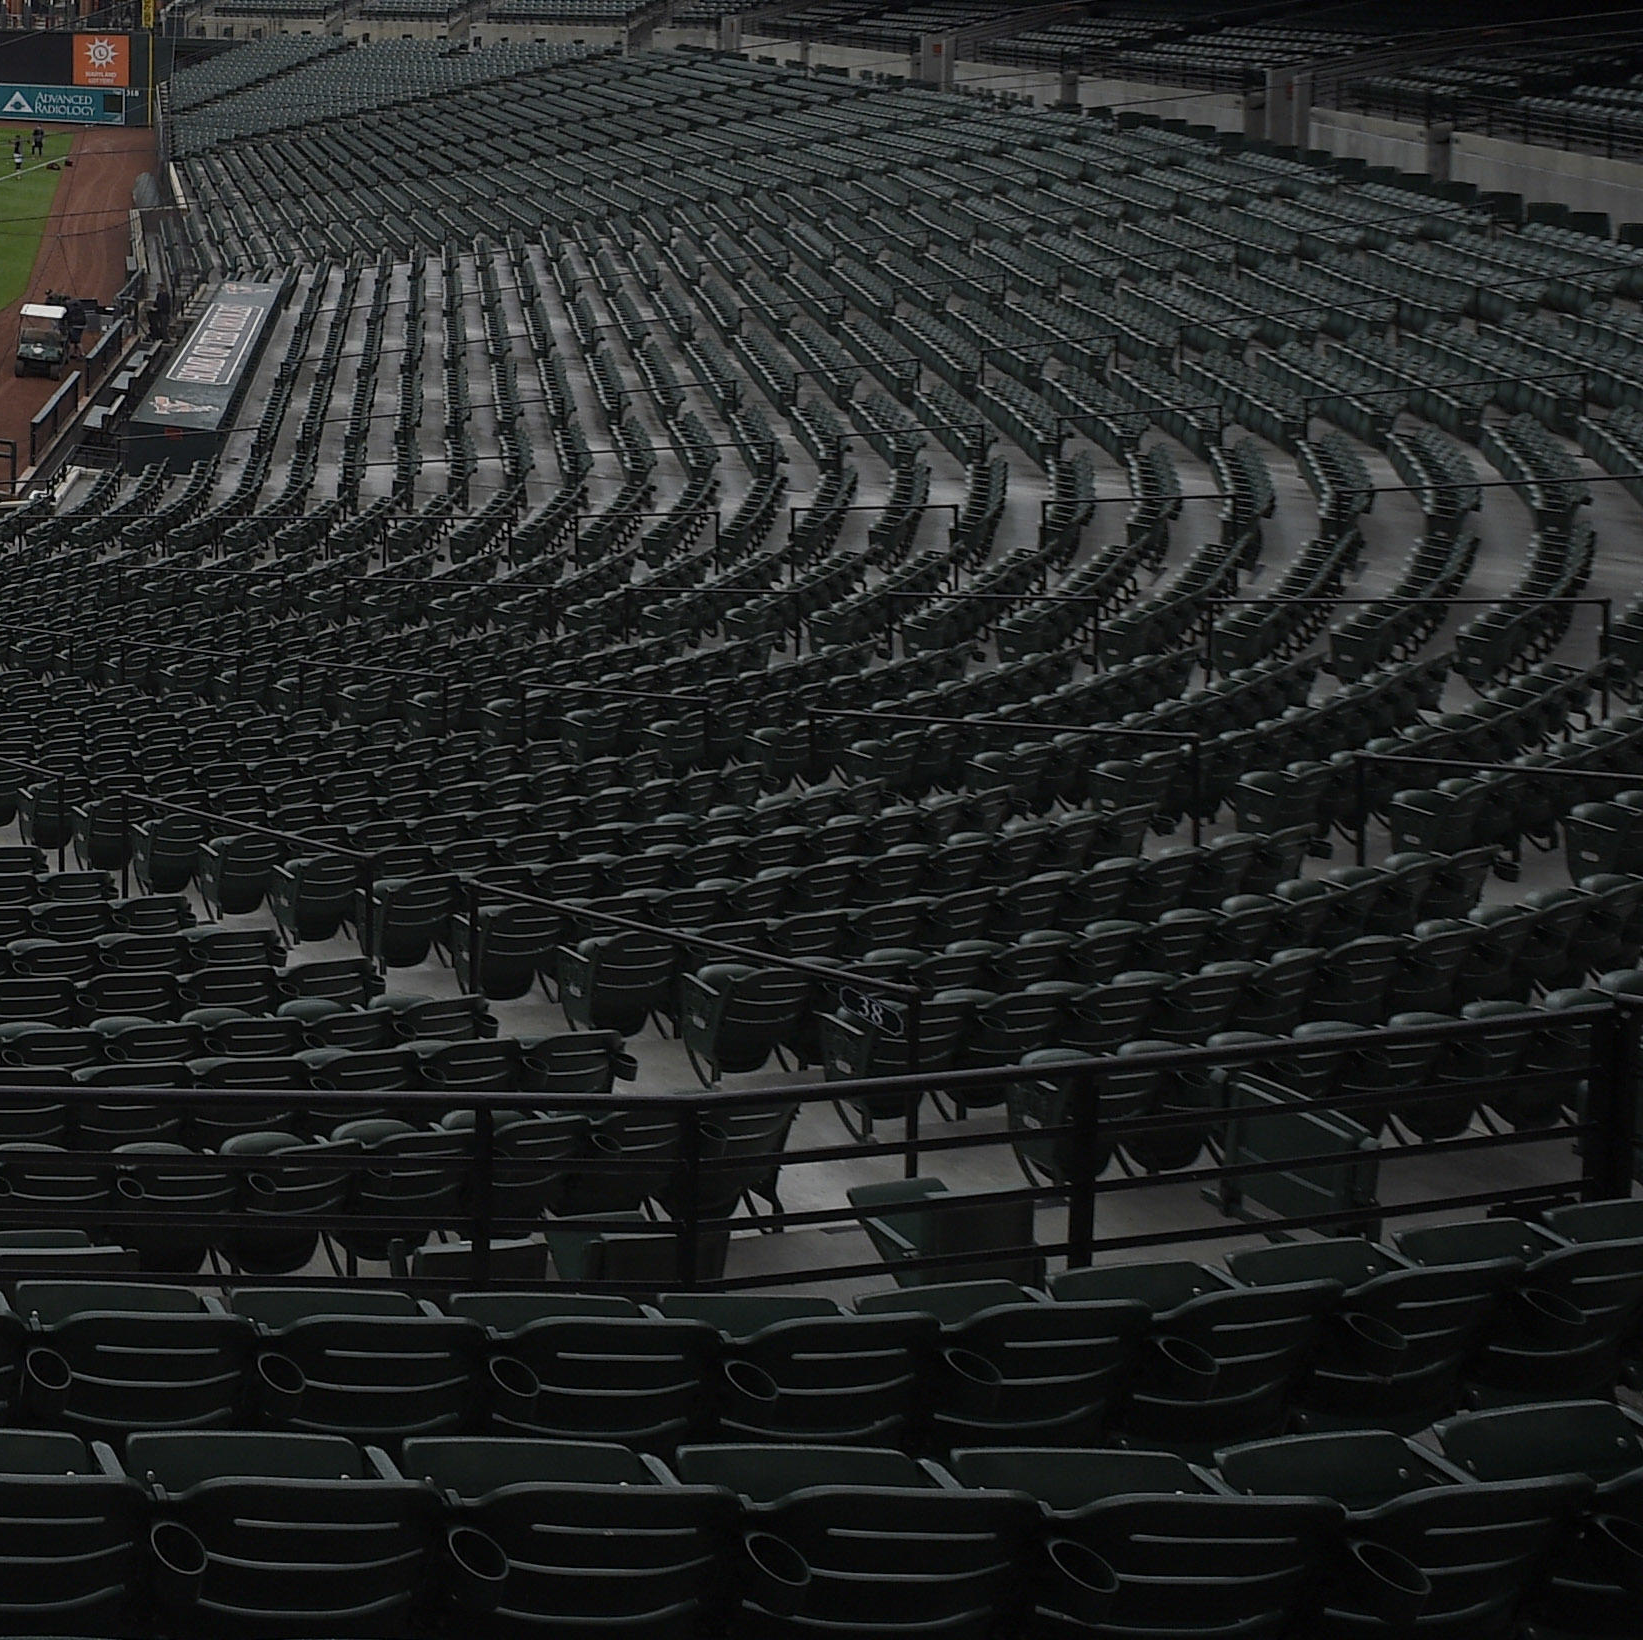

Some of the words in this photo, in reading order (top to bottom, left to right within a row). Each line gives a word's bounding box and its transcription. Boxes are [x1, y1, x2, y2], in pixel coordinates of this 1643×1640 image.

[35, 92, 93, 105] ADVANCED
[34, 102, 96, 117] RADIOLOGY
[857, 995, 884, 1026] 38
